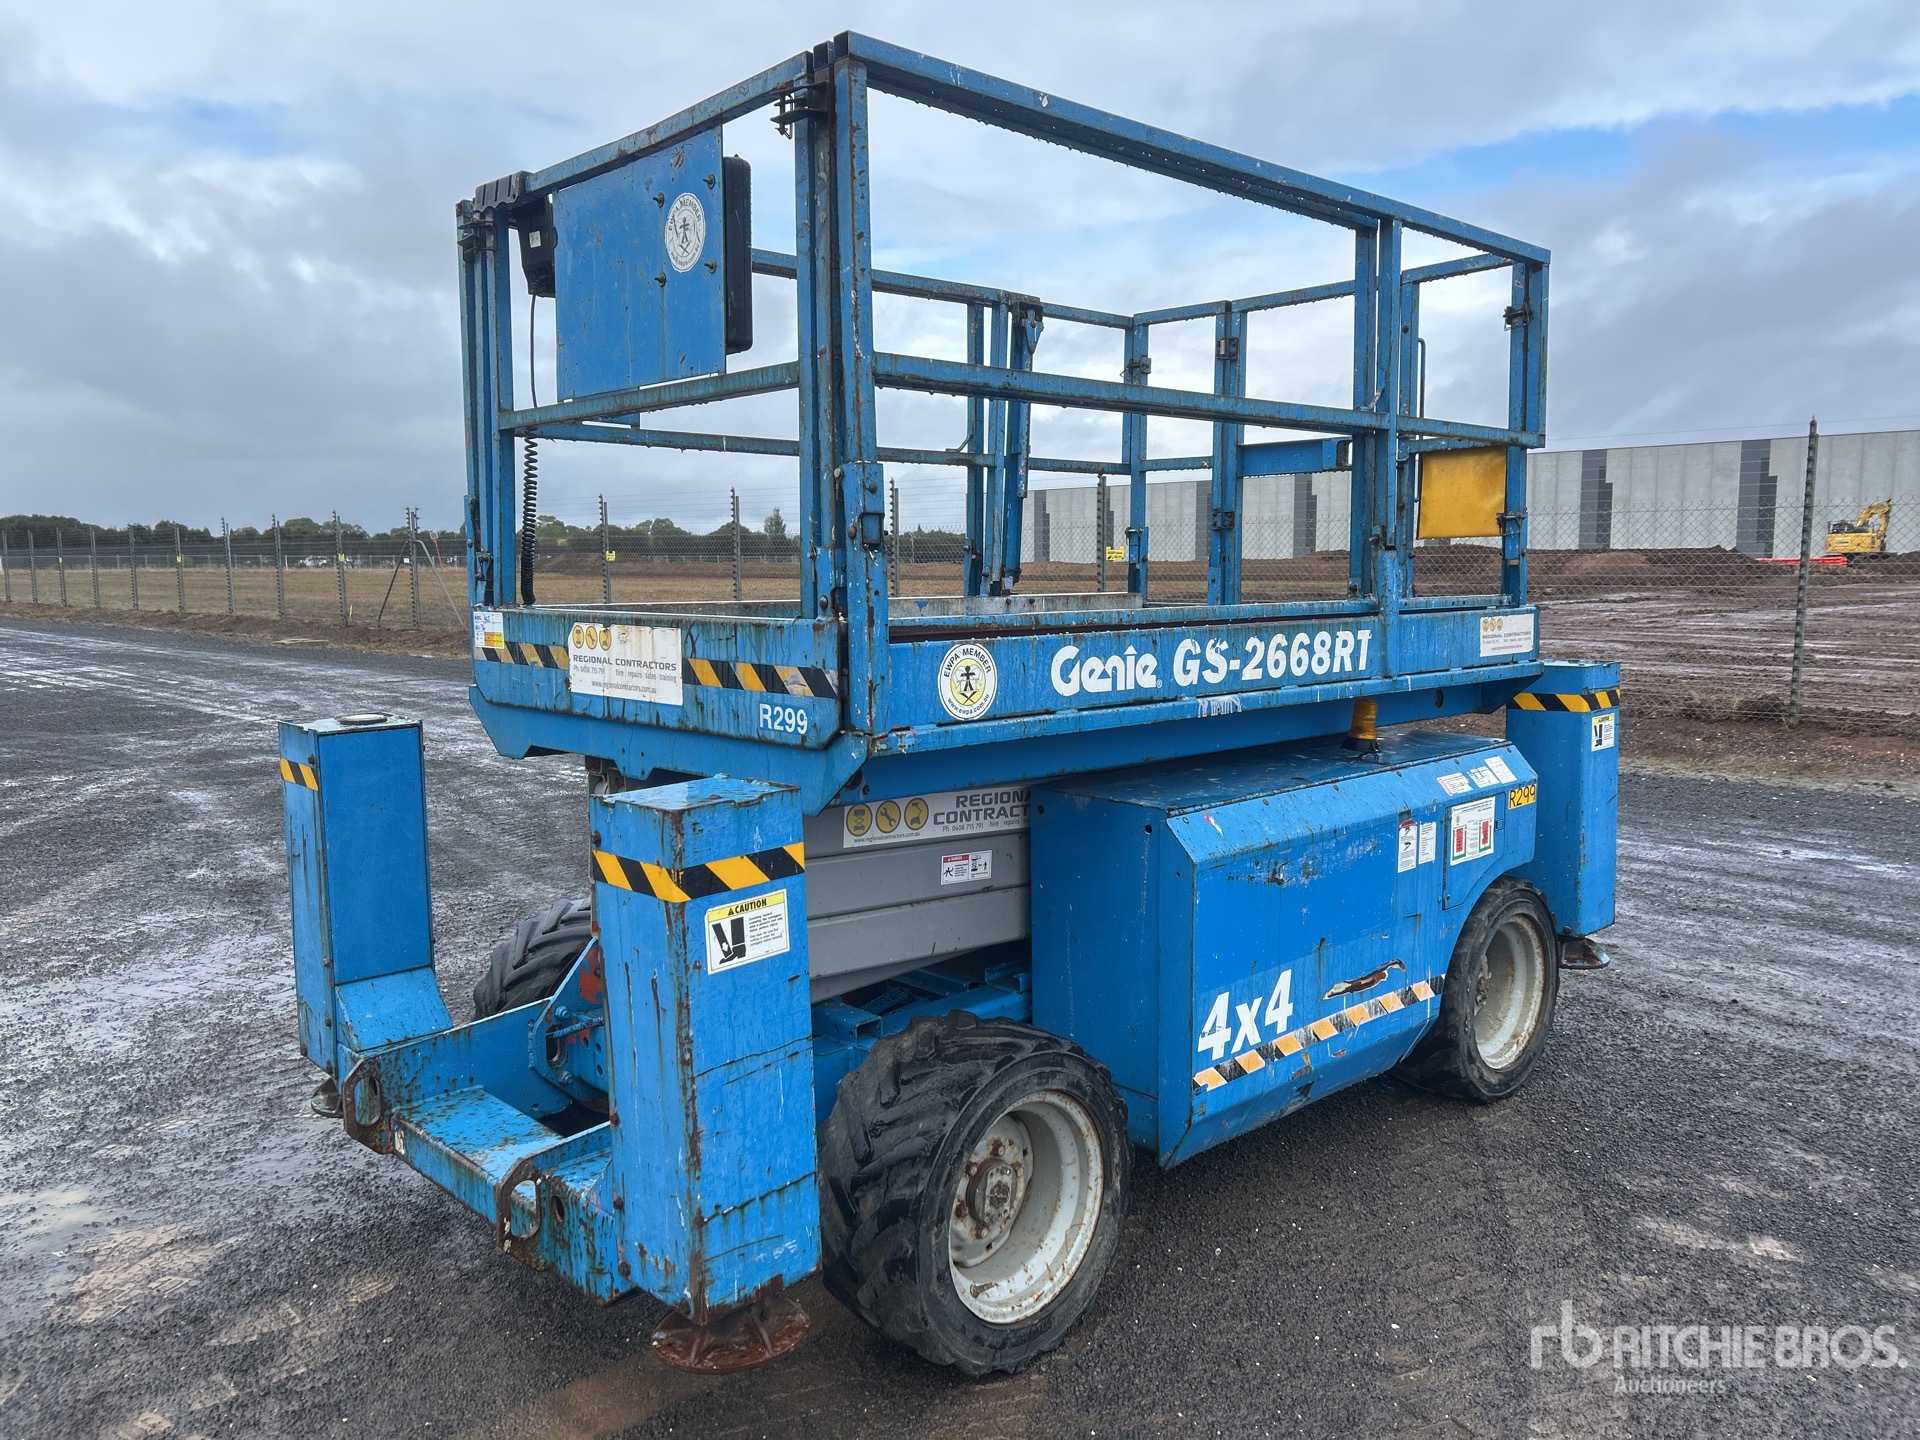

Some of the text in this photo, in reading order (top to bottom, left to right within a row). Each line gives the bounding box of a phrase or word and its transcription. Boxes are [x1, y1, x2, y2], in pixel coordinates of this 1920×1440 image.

[573, 654, 677, 671] REGIONAL CONTRACTORS
[943, 647, 992, 678] EWPA MEMBER
[1173, 629, 1373, 687] GS-2668RT
[615, 668, 625, 676] hire
[627, 670, 643, 679] repairs
[644, 671, 657, 680] sales
[659, 673, 677, 684] training
[948, 693, 990, 716] www.ewpa.com.au
[759, 703, 808, 735] R299
[1508, 785, 1537, 808] R299
[853, 831, 920, 844] www.regionalcontractors.com.au
[942, 825, 951, 833] Ph.
[951, 824, 965, 833] 0408
[965, 823, 975, 831] 715
[989, 820, 999, 828] hire
[1003, 819, 1020, 828] repairs
[735, 898, 767, 914] CAUTION
[1197, 968, 1294, 1061] 4x4
